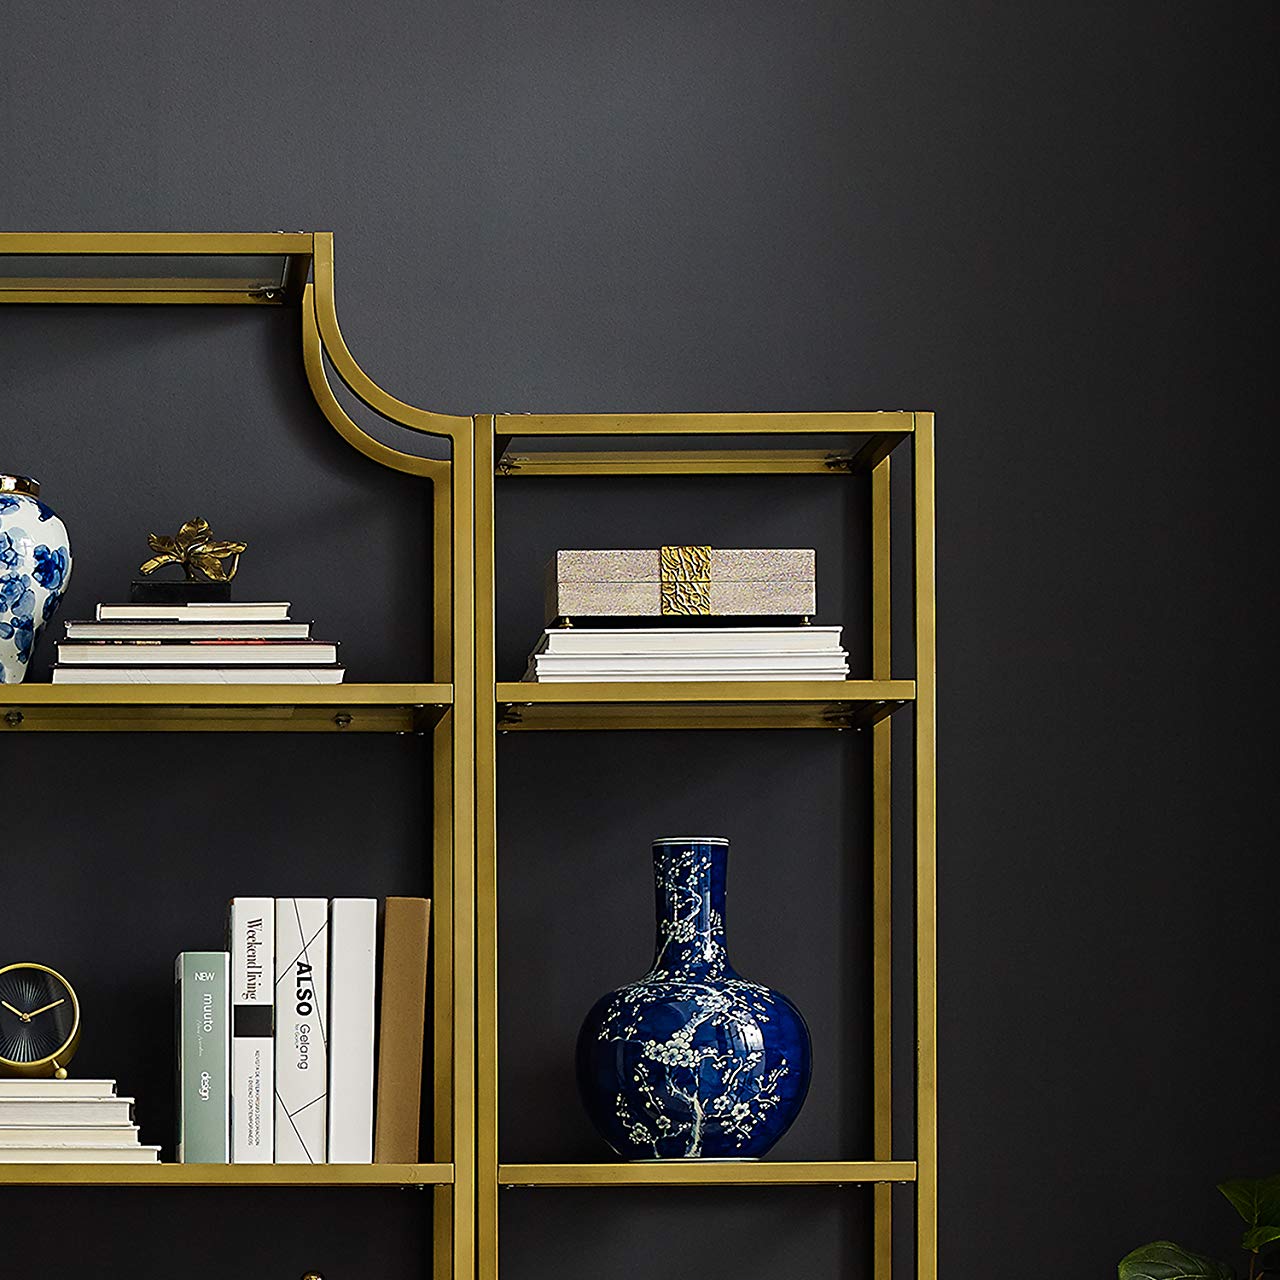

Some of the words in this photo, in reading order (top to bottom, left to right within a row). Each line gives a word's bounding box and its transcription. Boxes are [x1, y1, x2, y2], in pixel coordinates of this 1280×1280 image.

[247, 918, 263, 968] Weekend
[194, 971, 216, 982] NEW
[241, 971, 263, 1001] living
[295, 961, 313, 1017] ALSO
[202, 993, 214, 1032] muuto
[296, 1023, 310, 1070] Gelang
[198, 1071, 211, 1101] design
